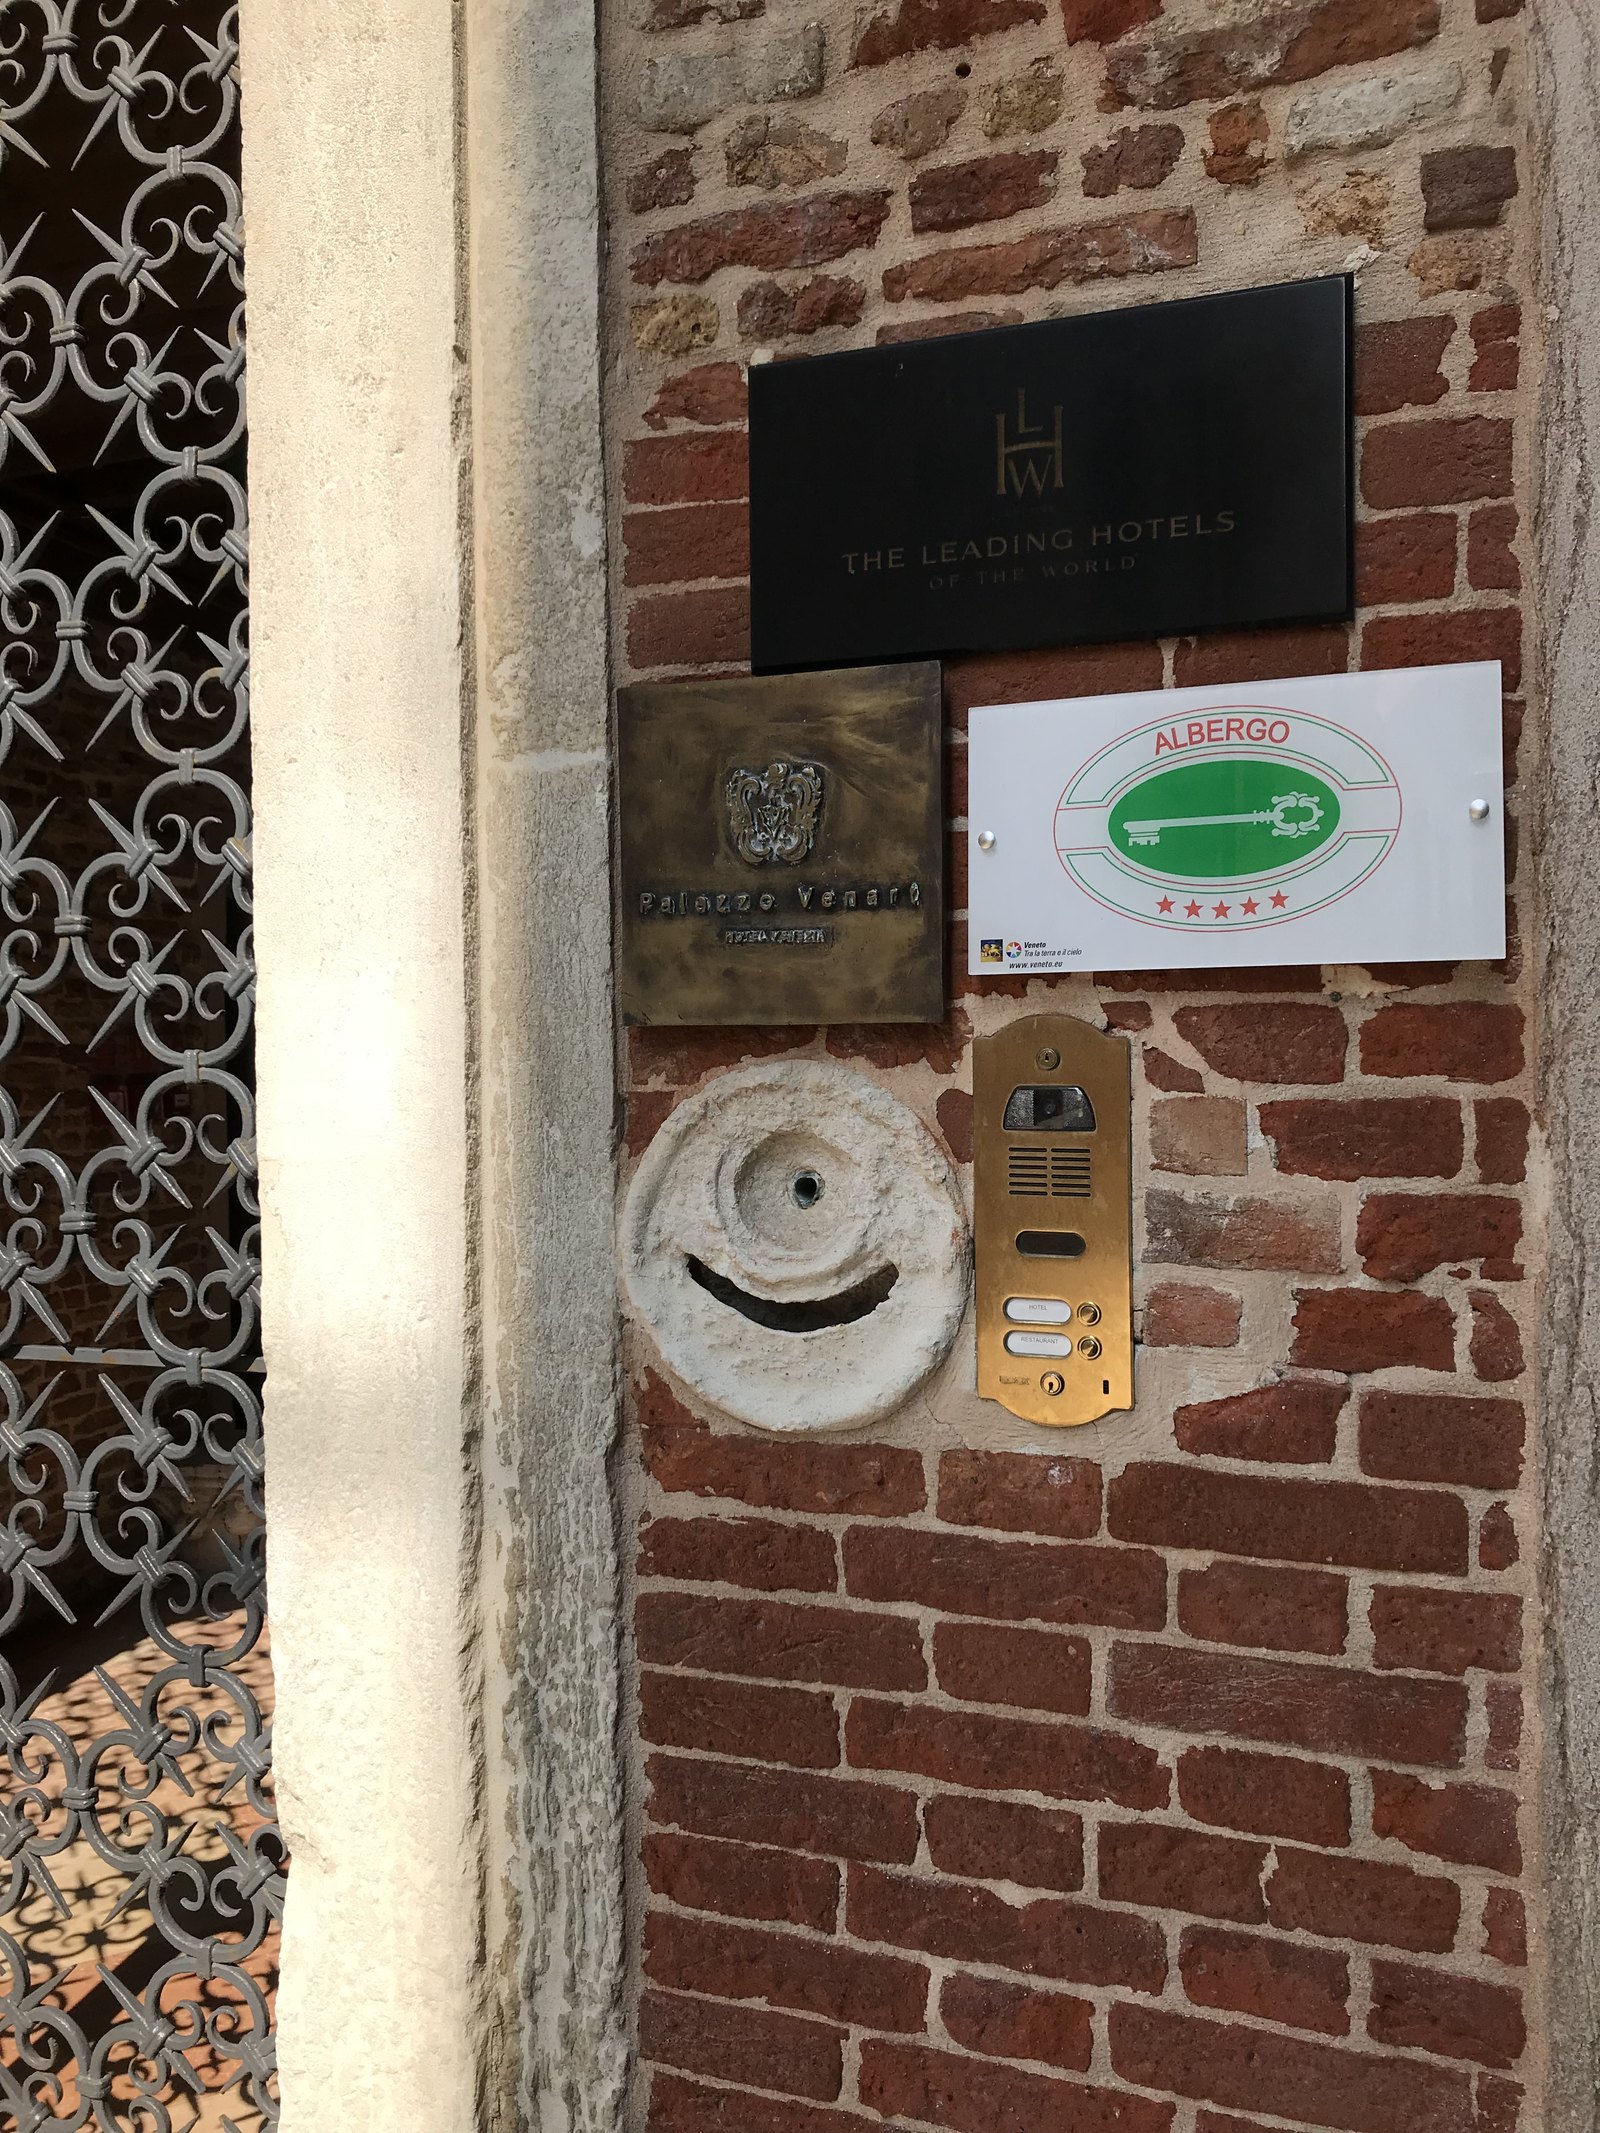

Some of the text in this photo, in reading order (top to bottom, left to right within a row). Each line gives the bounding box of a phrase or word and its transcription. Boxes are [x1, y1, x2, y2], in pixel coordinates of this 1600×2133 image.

[842, 511, 1235, 575] THE LEADING HOTELS
[929, 555, 1137, 591] OF THE WORLD
[1155, 718, 1290, 755] ALBERGO
[638, 891, 775, 915] Palazzo
[1024, 941, 1046, 949] Veneto
[1034, 949, 1041, 957] la
[1067, 948, 1082, 956] cielo
[1021, 1336, 1058, 1344] RESTAURANT
